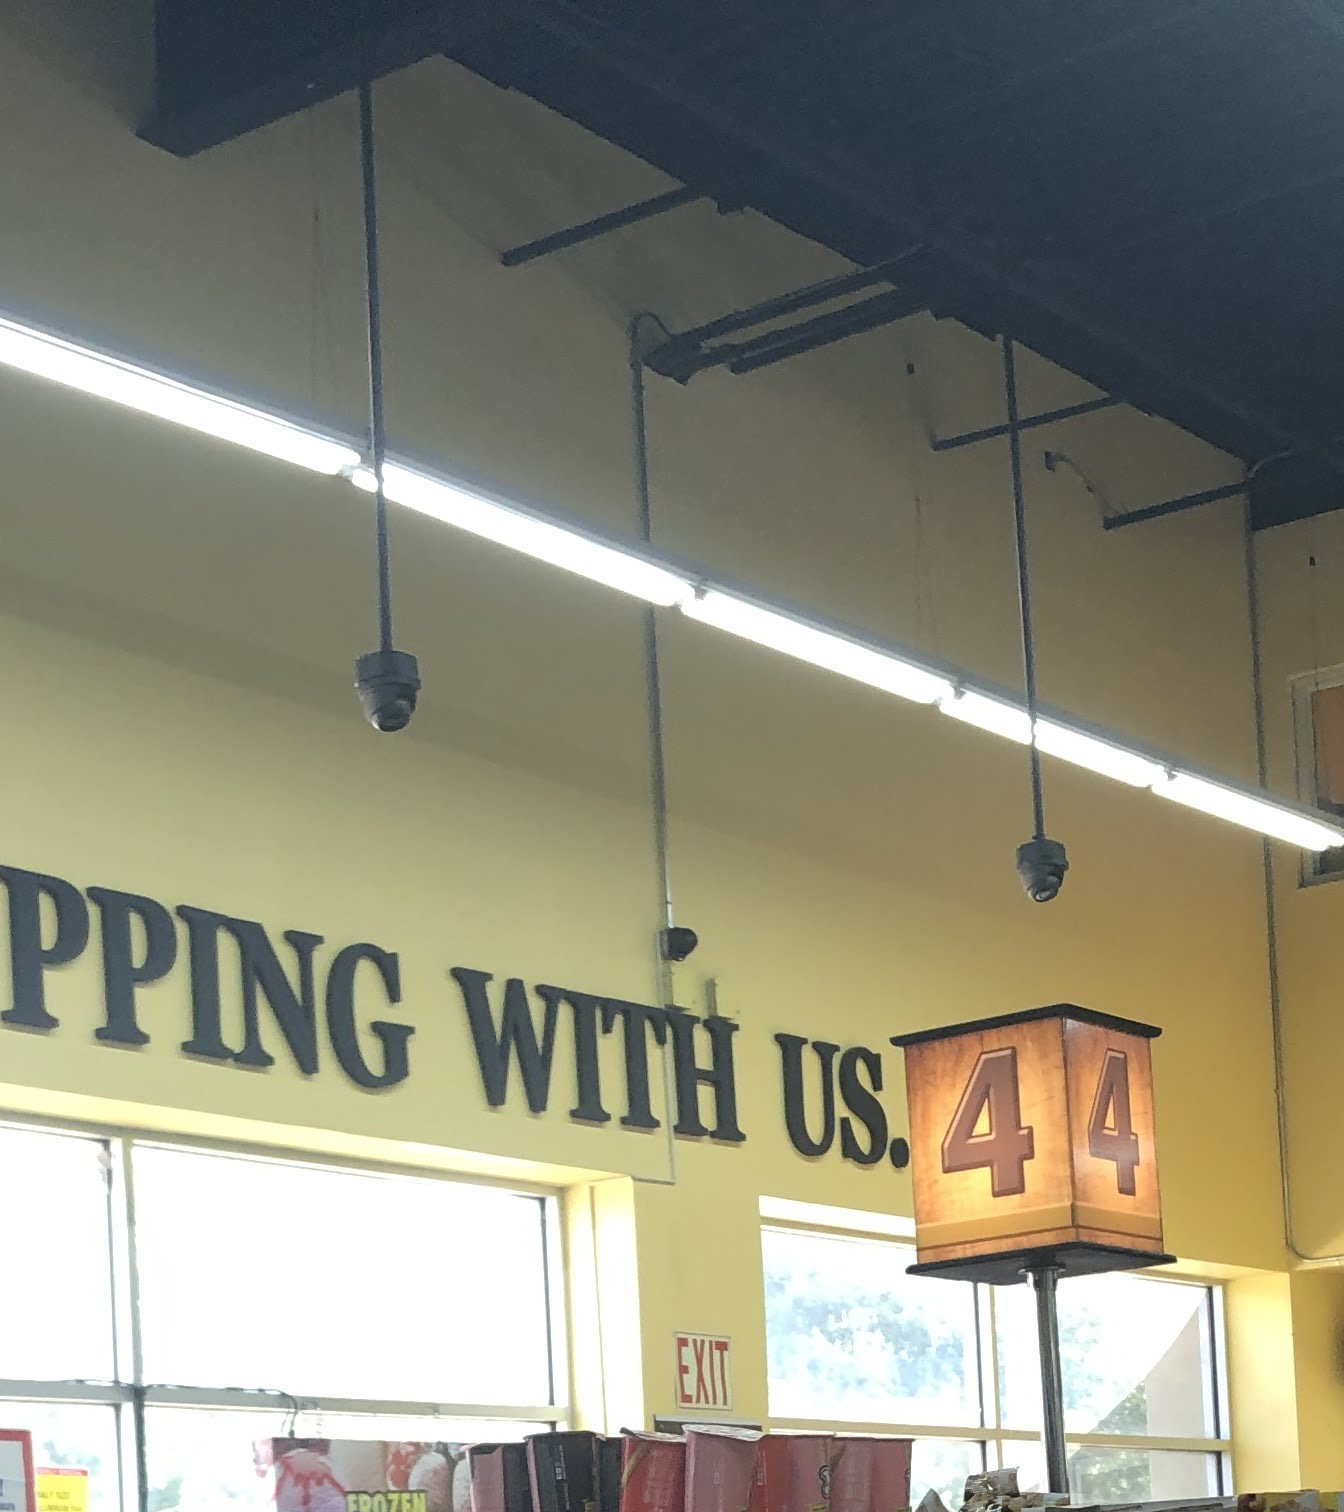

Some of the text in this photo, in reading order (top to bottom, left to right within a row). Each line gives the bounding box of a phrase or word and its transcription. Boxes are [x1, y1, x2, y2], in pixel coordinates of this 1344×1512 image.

[450, 965, 910, 1169] WITH US.
[940, 1047, 1036, 1198] 4
[1086, 1047, 1141, 1197] 4
[675, 1338, 731, 1408] EXIT
